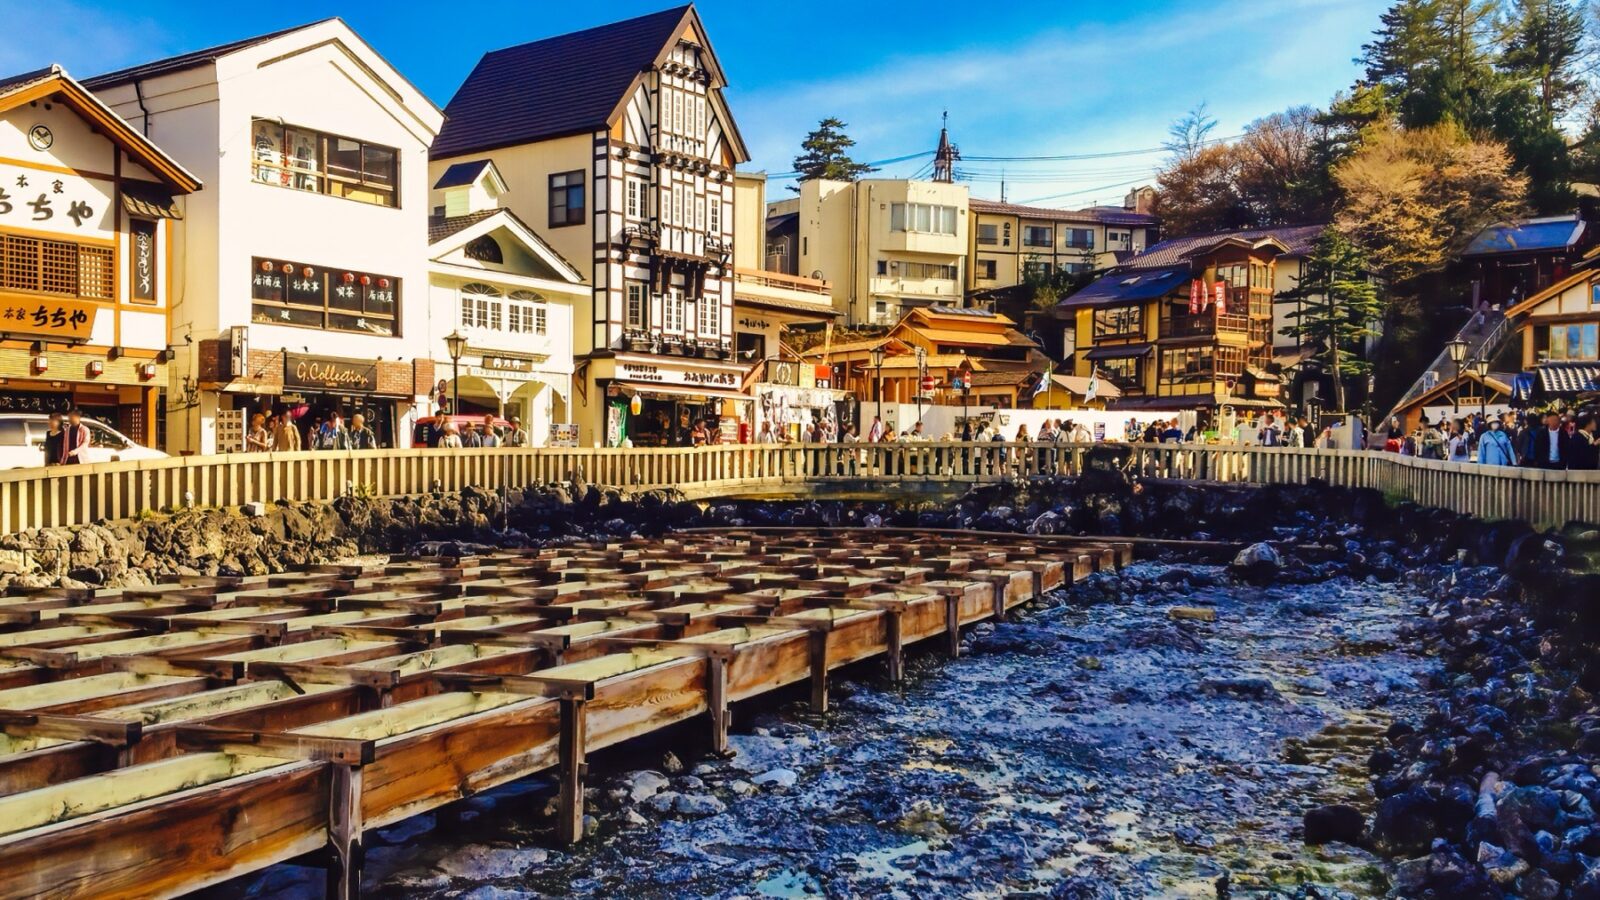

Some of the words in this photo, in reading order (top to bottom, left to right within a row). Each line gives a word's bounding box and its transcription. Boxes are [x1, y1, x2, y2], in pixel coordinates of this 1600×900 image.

[16, 174, 64, 194] 本家
[253, 273, 282, 288] 居酒屋
[293, 278, 319, 292] お食事
[336, 285, 355, 298] 喫茶
[368, 290, 393, 302] 居酒屋
[4, 307, 26, 320] 本家
[30, 305, 87, 330] ちちや
[296, 361, 369, 385] G.Collection
